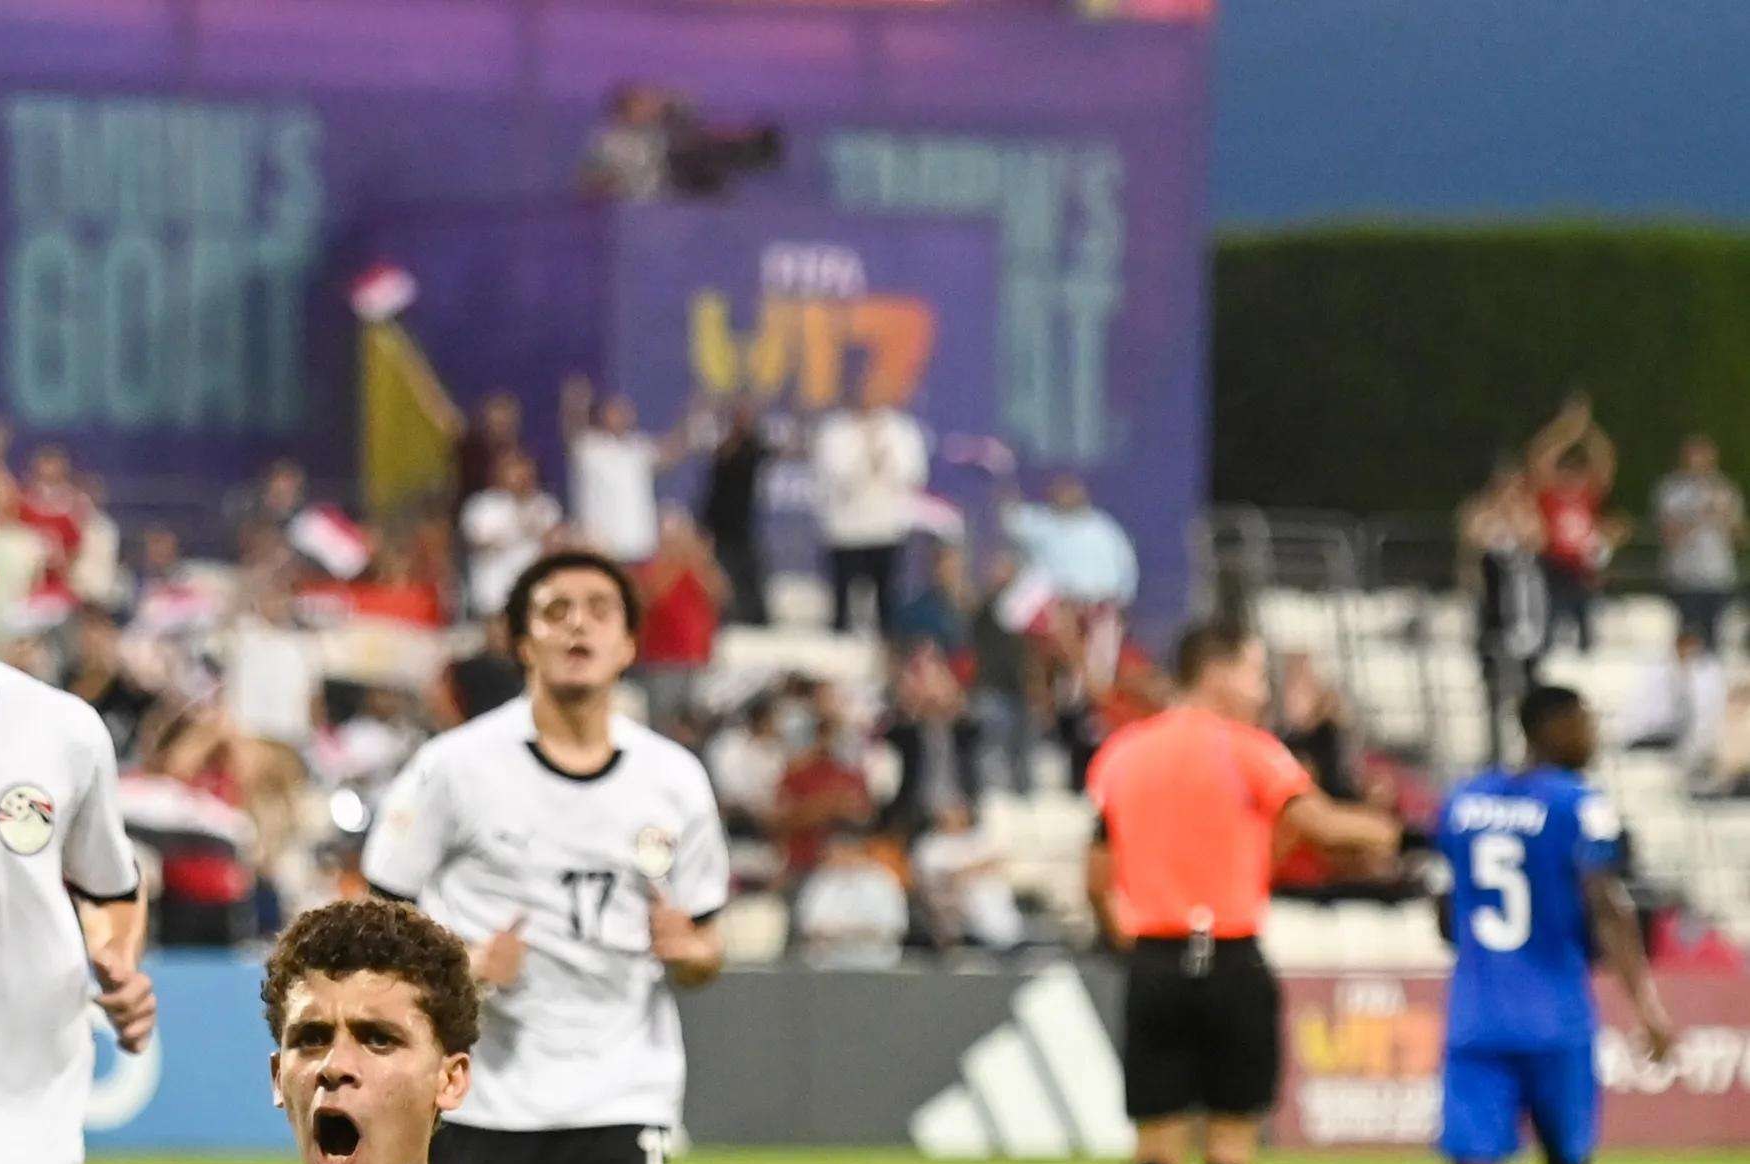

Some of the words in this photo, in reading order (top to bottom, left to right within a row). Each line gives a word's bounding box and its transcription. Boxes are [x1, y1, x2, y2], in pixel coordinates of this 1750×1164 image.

[8, 234, 310, 424] GOAT
[560, 870, 616, 941] 17
[1470, 832, 1532, 952] 5
